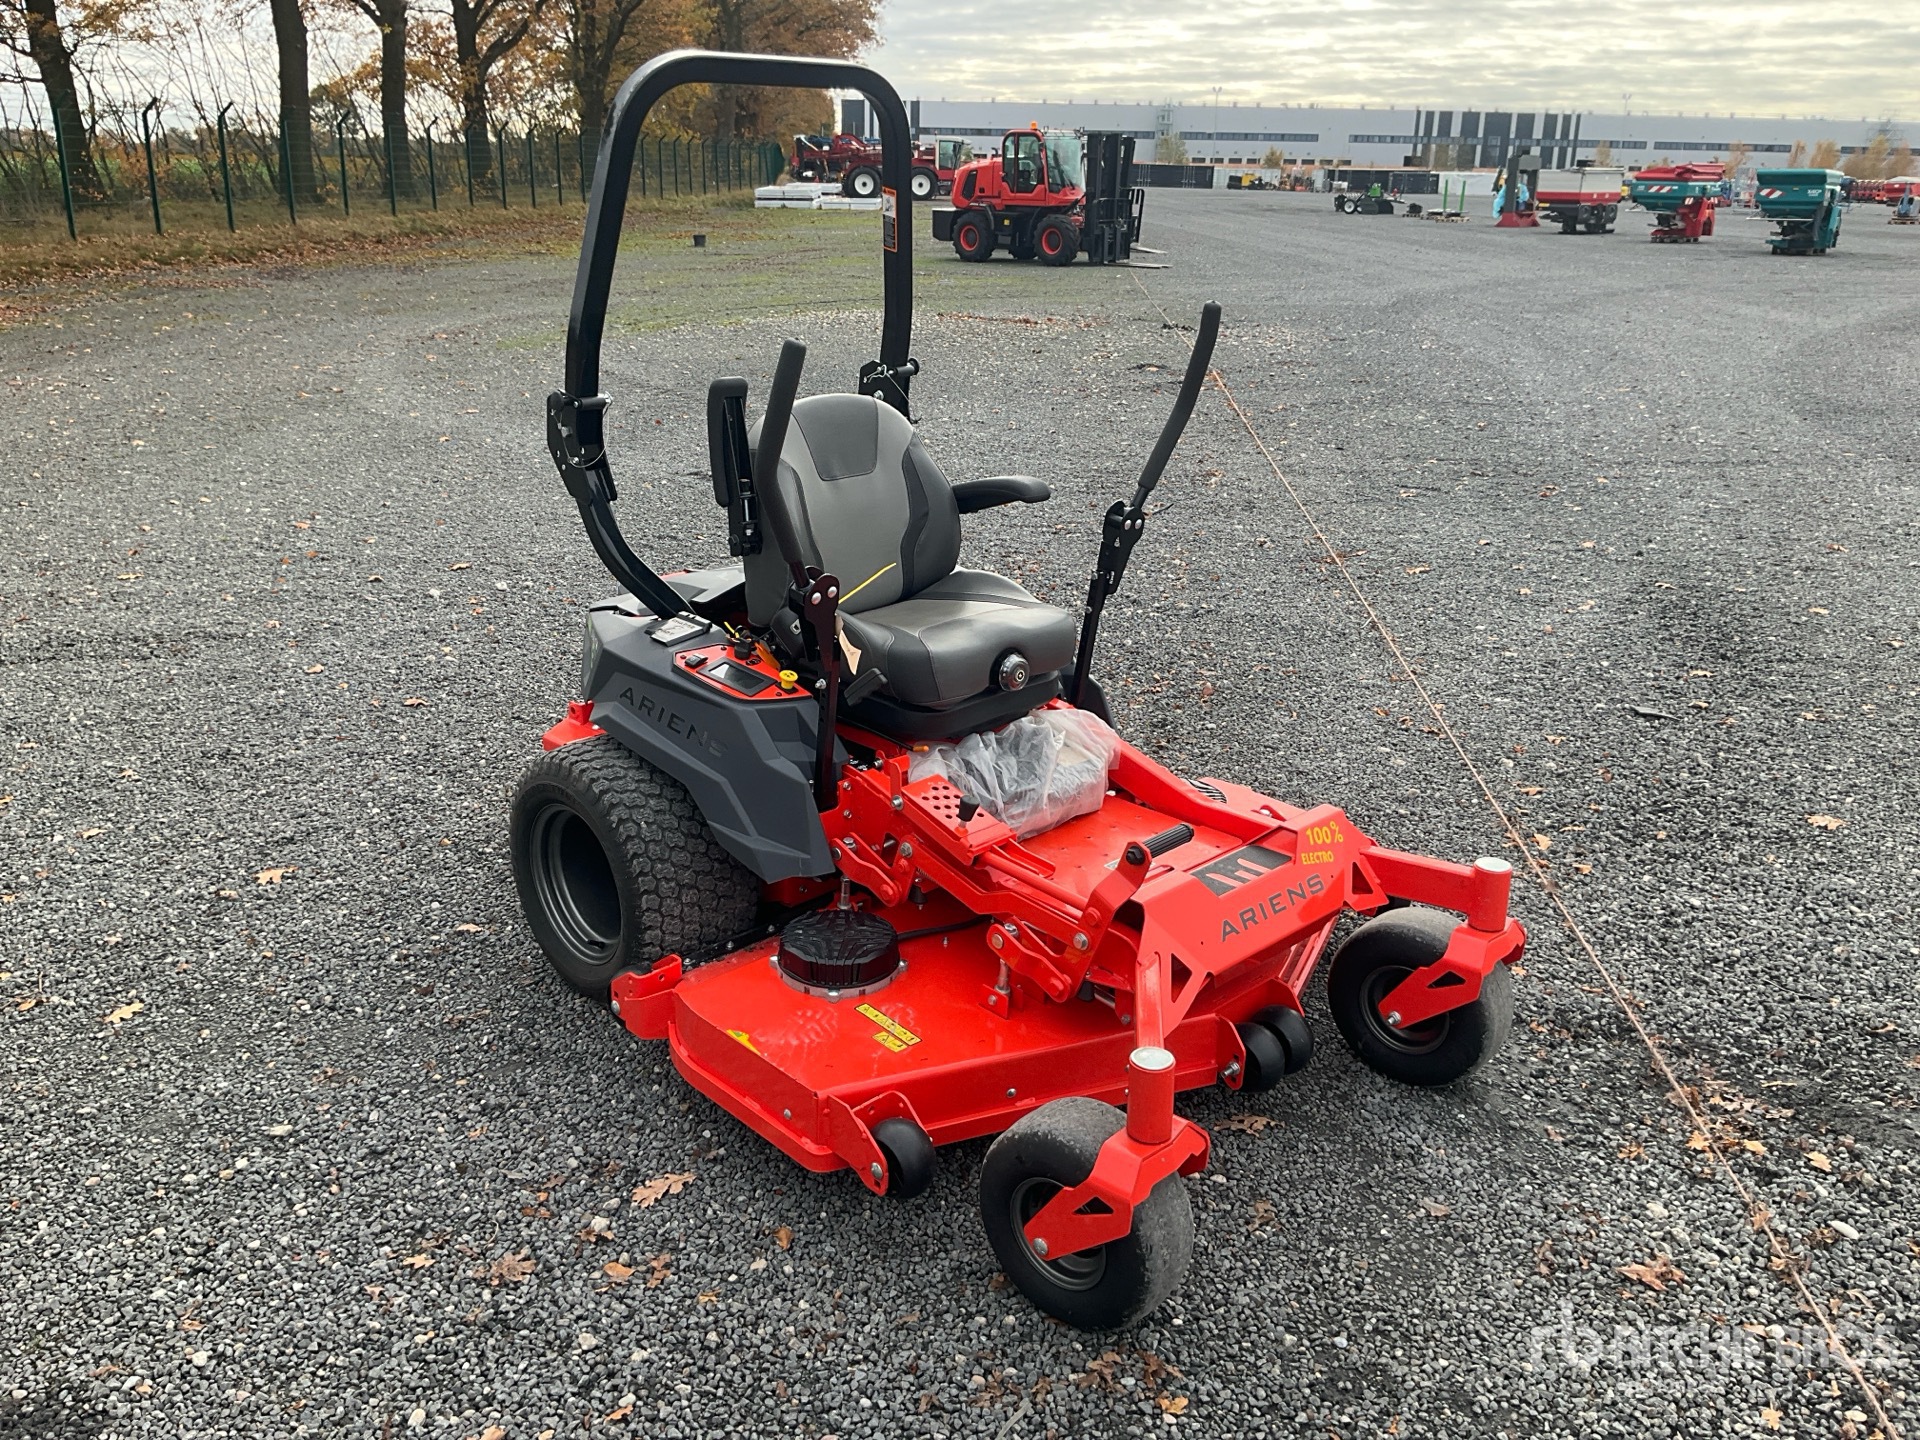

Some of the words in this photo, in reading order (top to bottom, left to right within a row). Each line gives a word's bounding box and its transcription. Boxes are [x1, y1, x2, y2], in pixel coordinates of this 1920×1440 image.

[619, 687, 729, 758] ARIENS
[1306, 821, 1343, 845] 100%
[1302, 851, 1333, 865] ELECTRO
[1222, 874, 1325, 943] ARIENS
